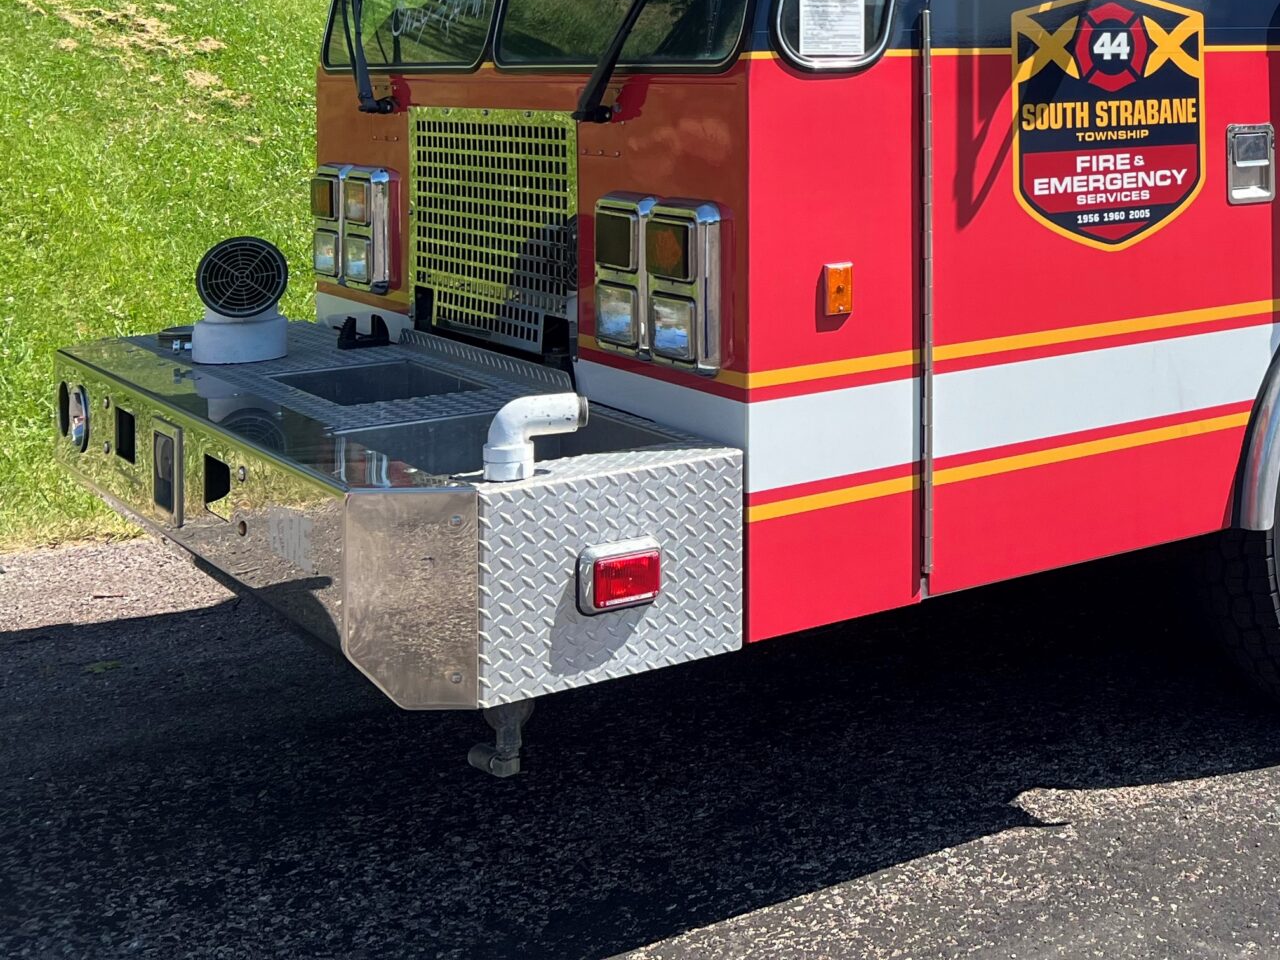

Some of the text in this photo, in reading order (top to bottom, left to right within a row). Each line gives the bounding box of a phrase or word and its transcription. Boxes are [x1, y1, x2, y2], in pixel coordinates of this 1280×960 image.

[1093, 32, 1130, 60] 44
[1022, 98, 1197, 131] SOUTH STRABANE
[1076, 129, 1149, 142] TOWNSHIP
[1076, 153, 1145, 173] FIRE &
[1033, 168, 1188, 195] EMERGENCY
[1076, 190, 1150, 205] SERVICES
[1077, 209, 1151, 224] 1956 1960 2005
